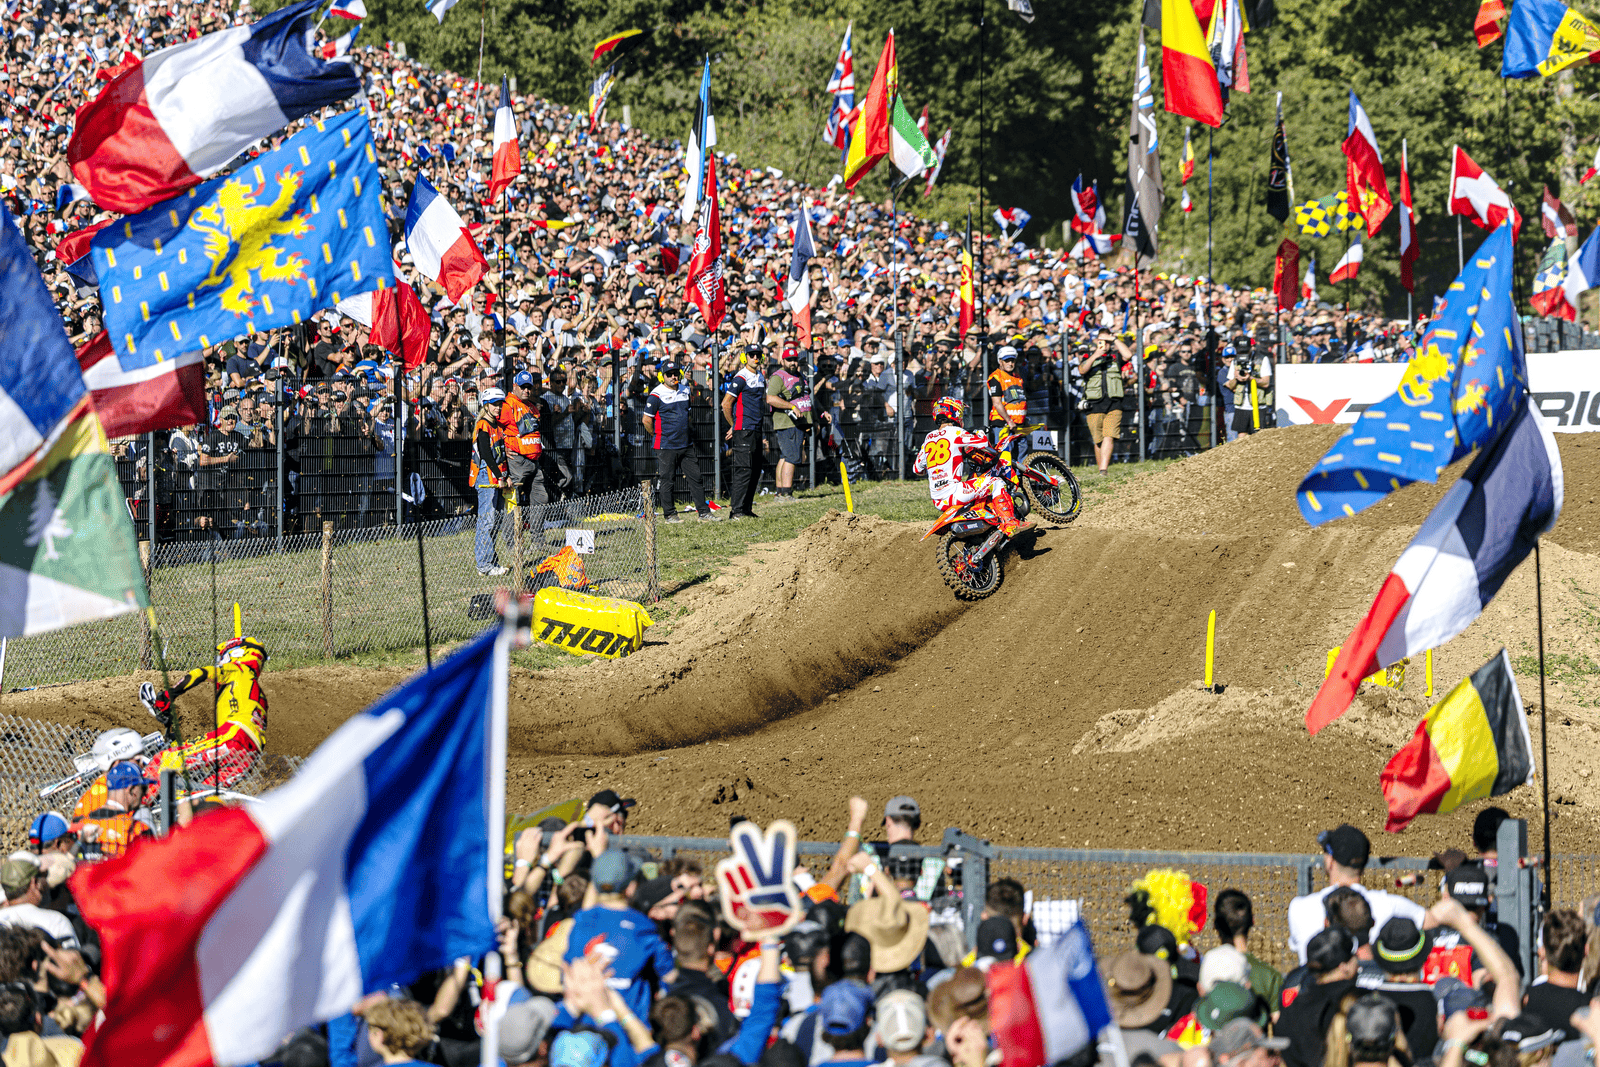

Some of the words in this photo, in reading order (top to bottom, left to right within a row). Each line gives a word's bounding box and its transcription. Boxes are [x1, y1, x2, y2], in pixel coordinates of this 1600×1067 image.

[1037, 436, 1052, 446] 4A
[925, 438, 951, 469] 28
[576, 536, 584, 548] 4
